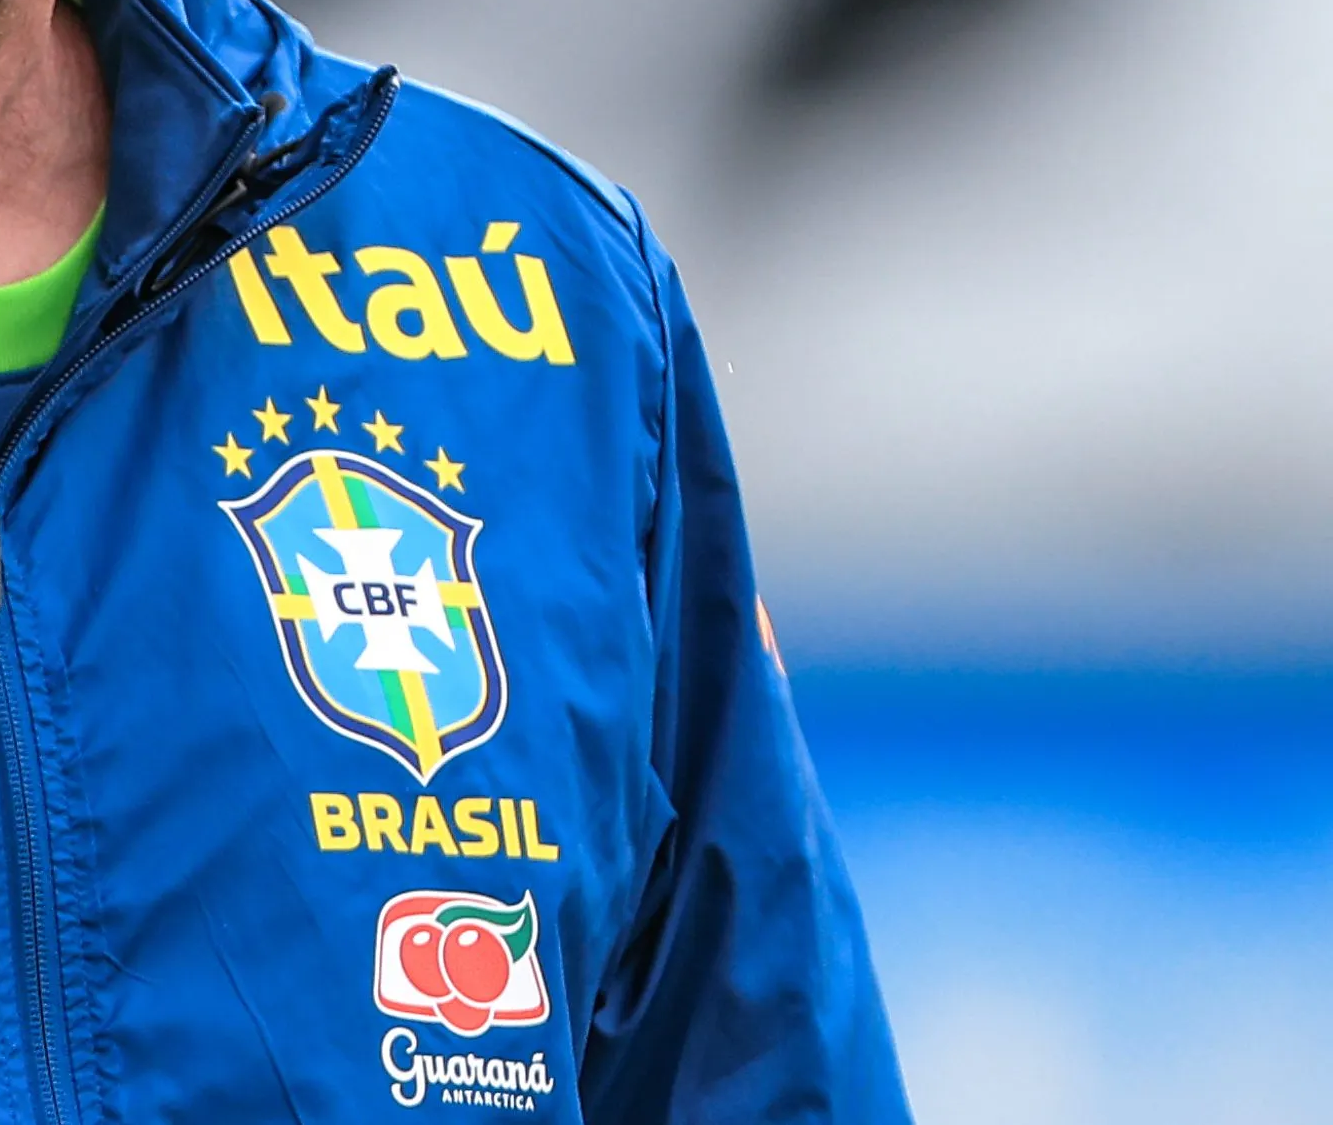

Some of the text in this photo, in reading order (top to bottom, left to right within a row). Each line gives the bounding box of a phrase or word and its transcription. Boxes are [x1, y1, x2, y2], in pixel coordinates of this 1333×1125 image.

[228, 221, 577, 366] Itaú
[333, 582, 418, 618] CBF
[309, 792, 559, 862] BRASIL
[381, 1027, 554, 1107] Guaraná
[442, 1089, 535, 1112] ANTARCTICA
